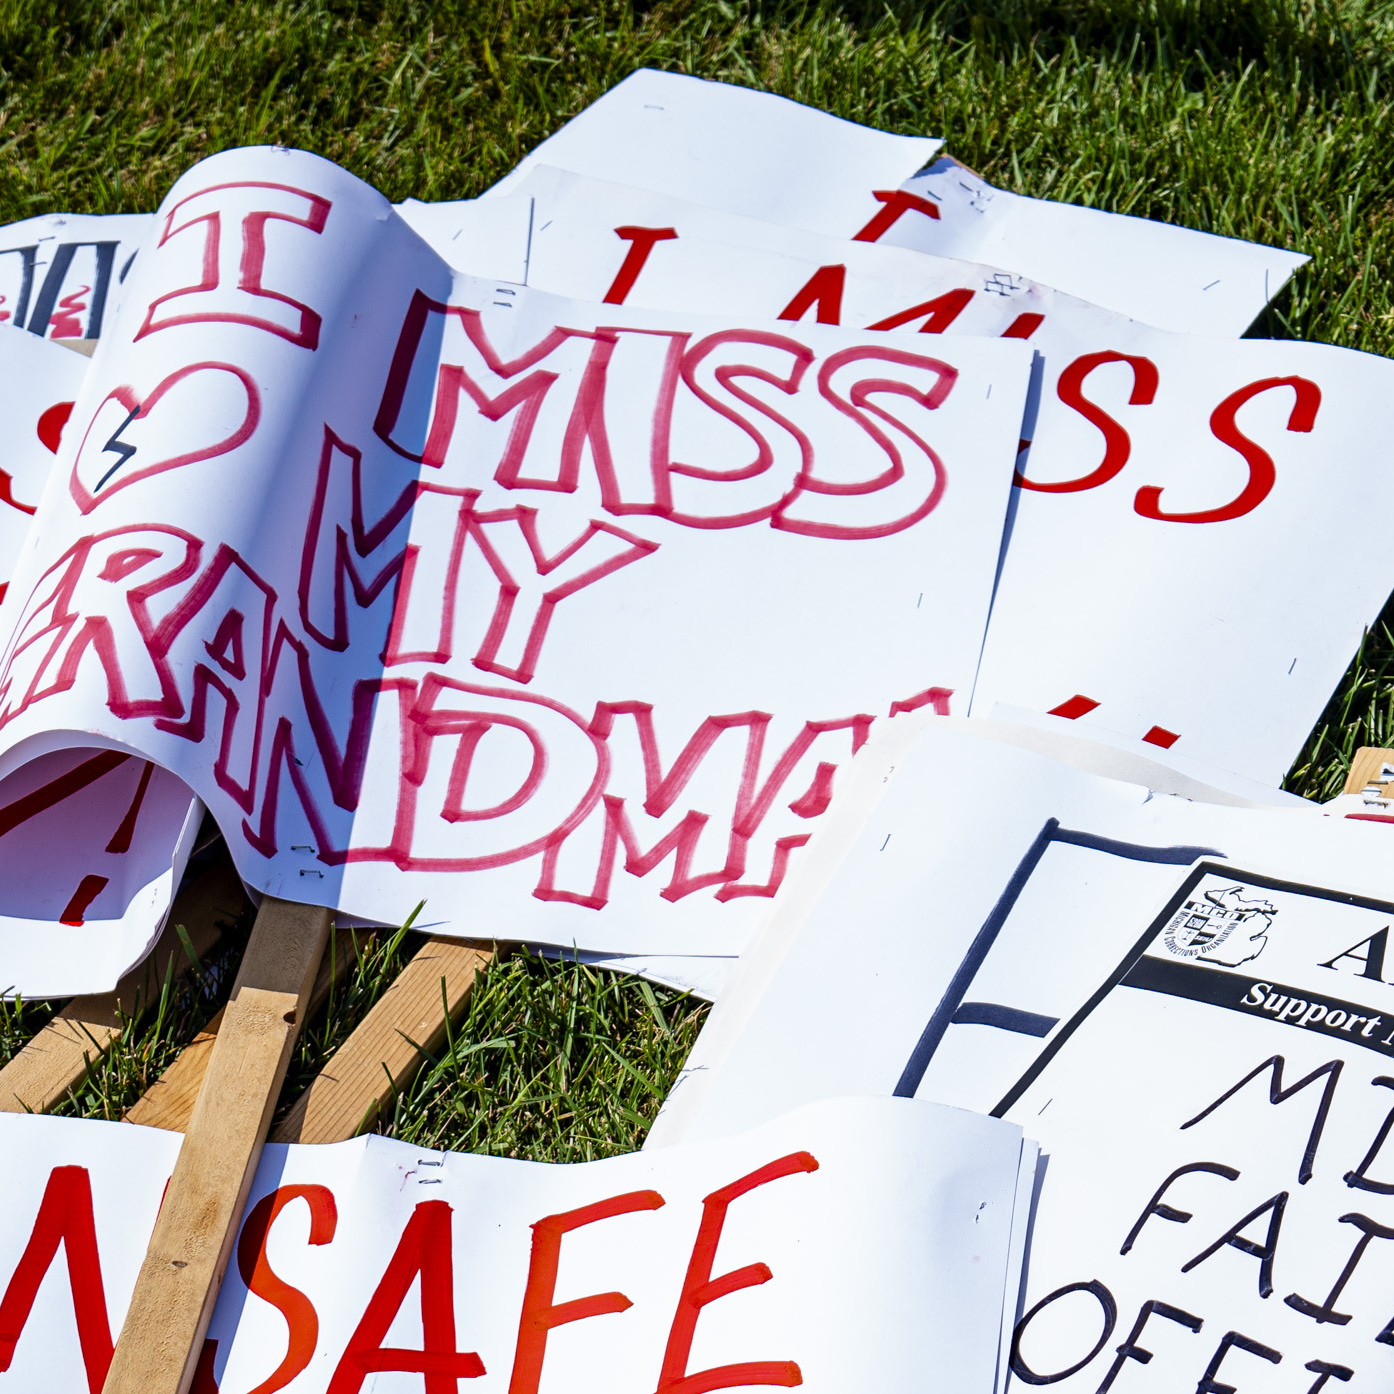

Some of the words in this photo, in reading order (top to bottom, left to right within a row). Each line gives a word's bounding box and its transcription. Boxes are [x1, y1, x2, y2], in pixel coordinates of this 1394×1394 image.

[134, 181, 333, 351] I
[374, 289, 958, 540] MISS
[297, 423, 661, 684] MY
[1191, 902, 1242, 921] MCO
[1239, 981, 1382, 1038] Support
